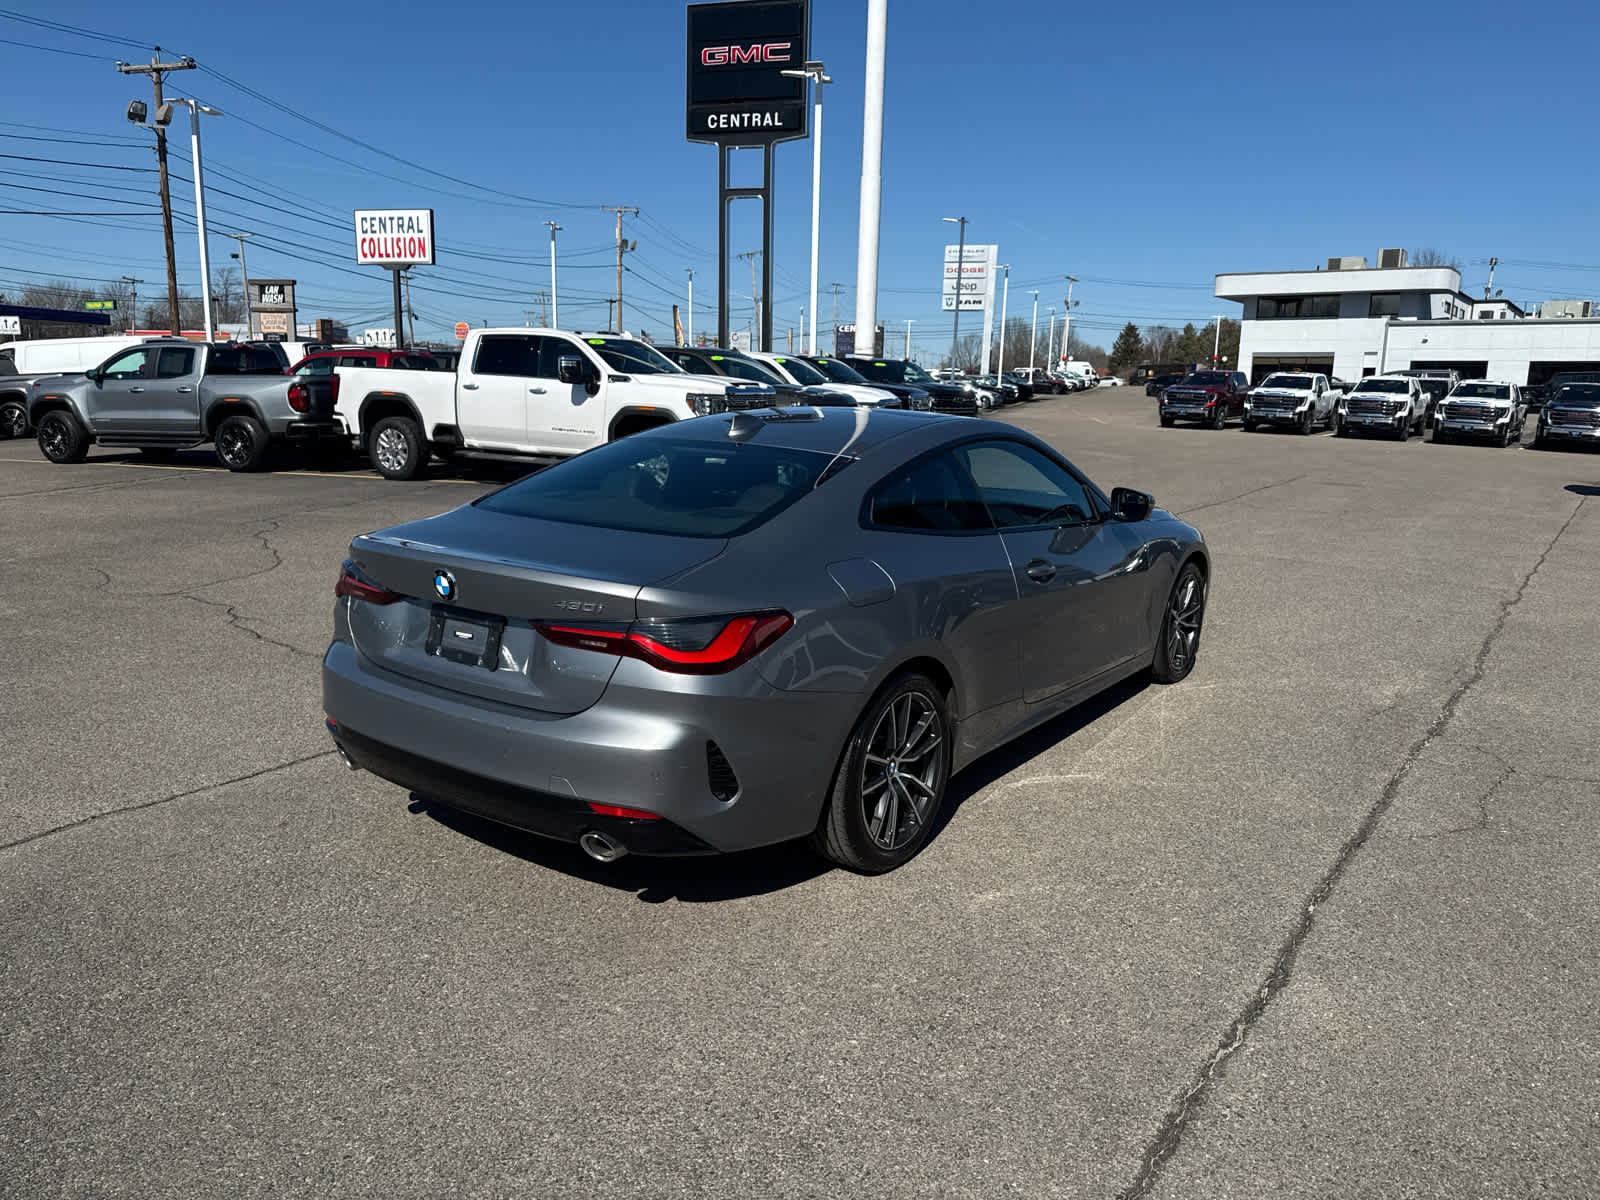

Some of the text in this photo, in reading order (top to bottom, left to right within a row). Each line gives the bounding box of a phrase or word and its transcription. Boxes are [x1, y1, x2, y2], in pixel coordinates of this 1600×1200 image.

[701, 42, 791, 66] GMC
[707, 112, 783, 129] CENTRAL
[360, 215, 424, 235] CENTRAL
[360, 236, 427, 259] COLLISION
[261, 294, 284, 304] WASH
[838, 324, 881, 333] CENL
